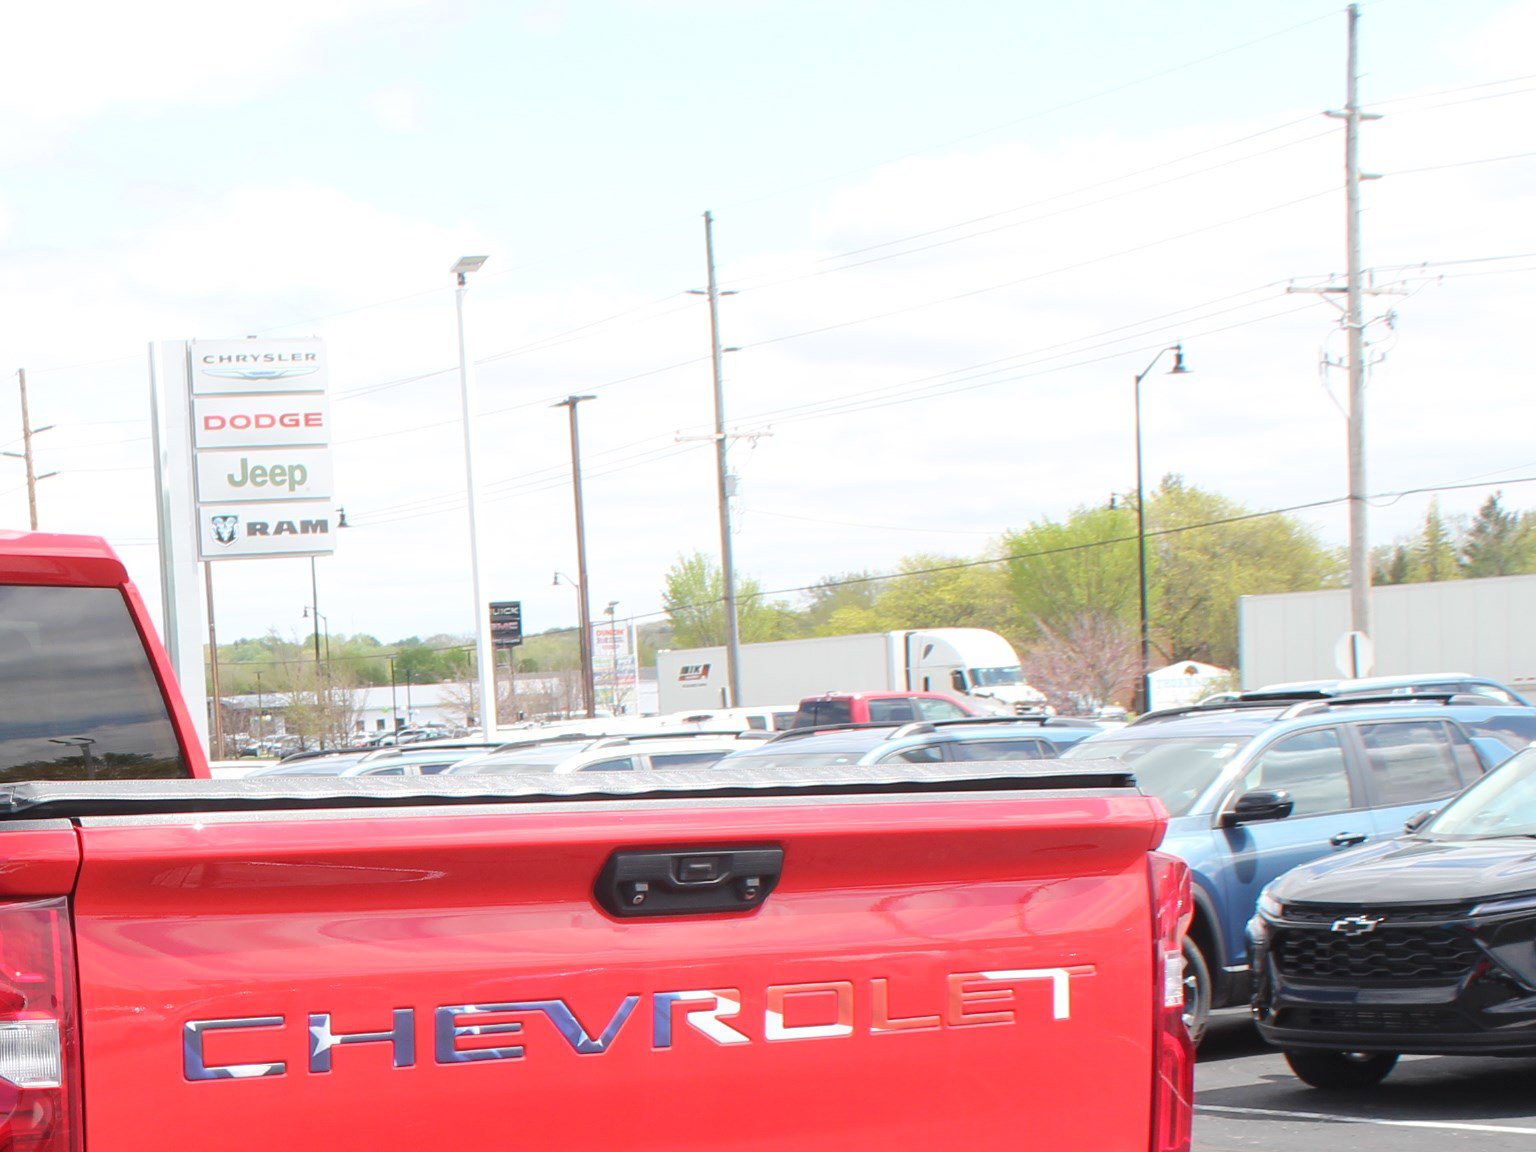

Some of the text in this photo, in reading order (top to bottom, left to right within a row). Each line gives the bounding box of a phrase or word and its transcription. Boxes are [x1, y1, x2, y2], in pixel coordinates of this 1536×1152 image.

[202, 353, 317, 364] CHRYSLER
[203, 412, 323, 430] DODGE
[227, 457, 308, 491] Jeep
[246, 519, 329, 537] RAM
[183, 965, 1096, 1082] CHEVROLET
